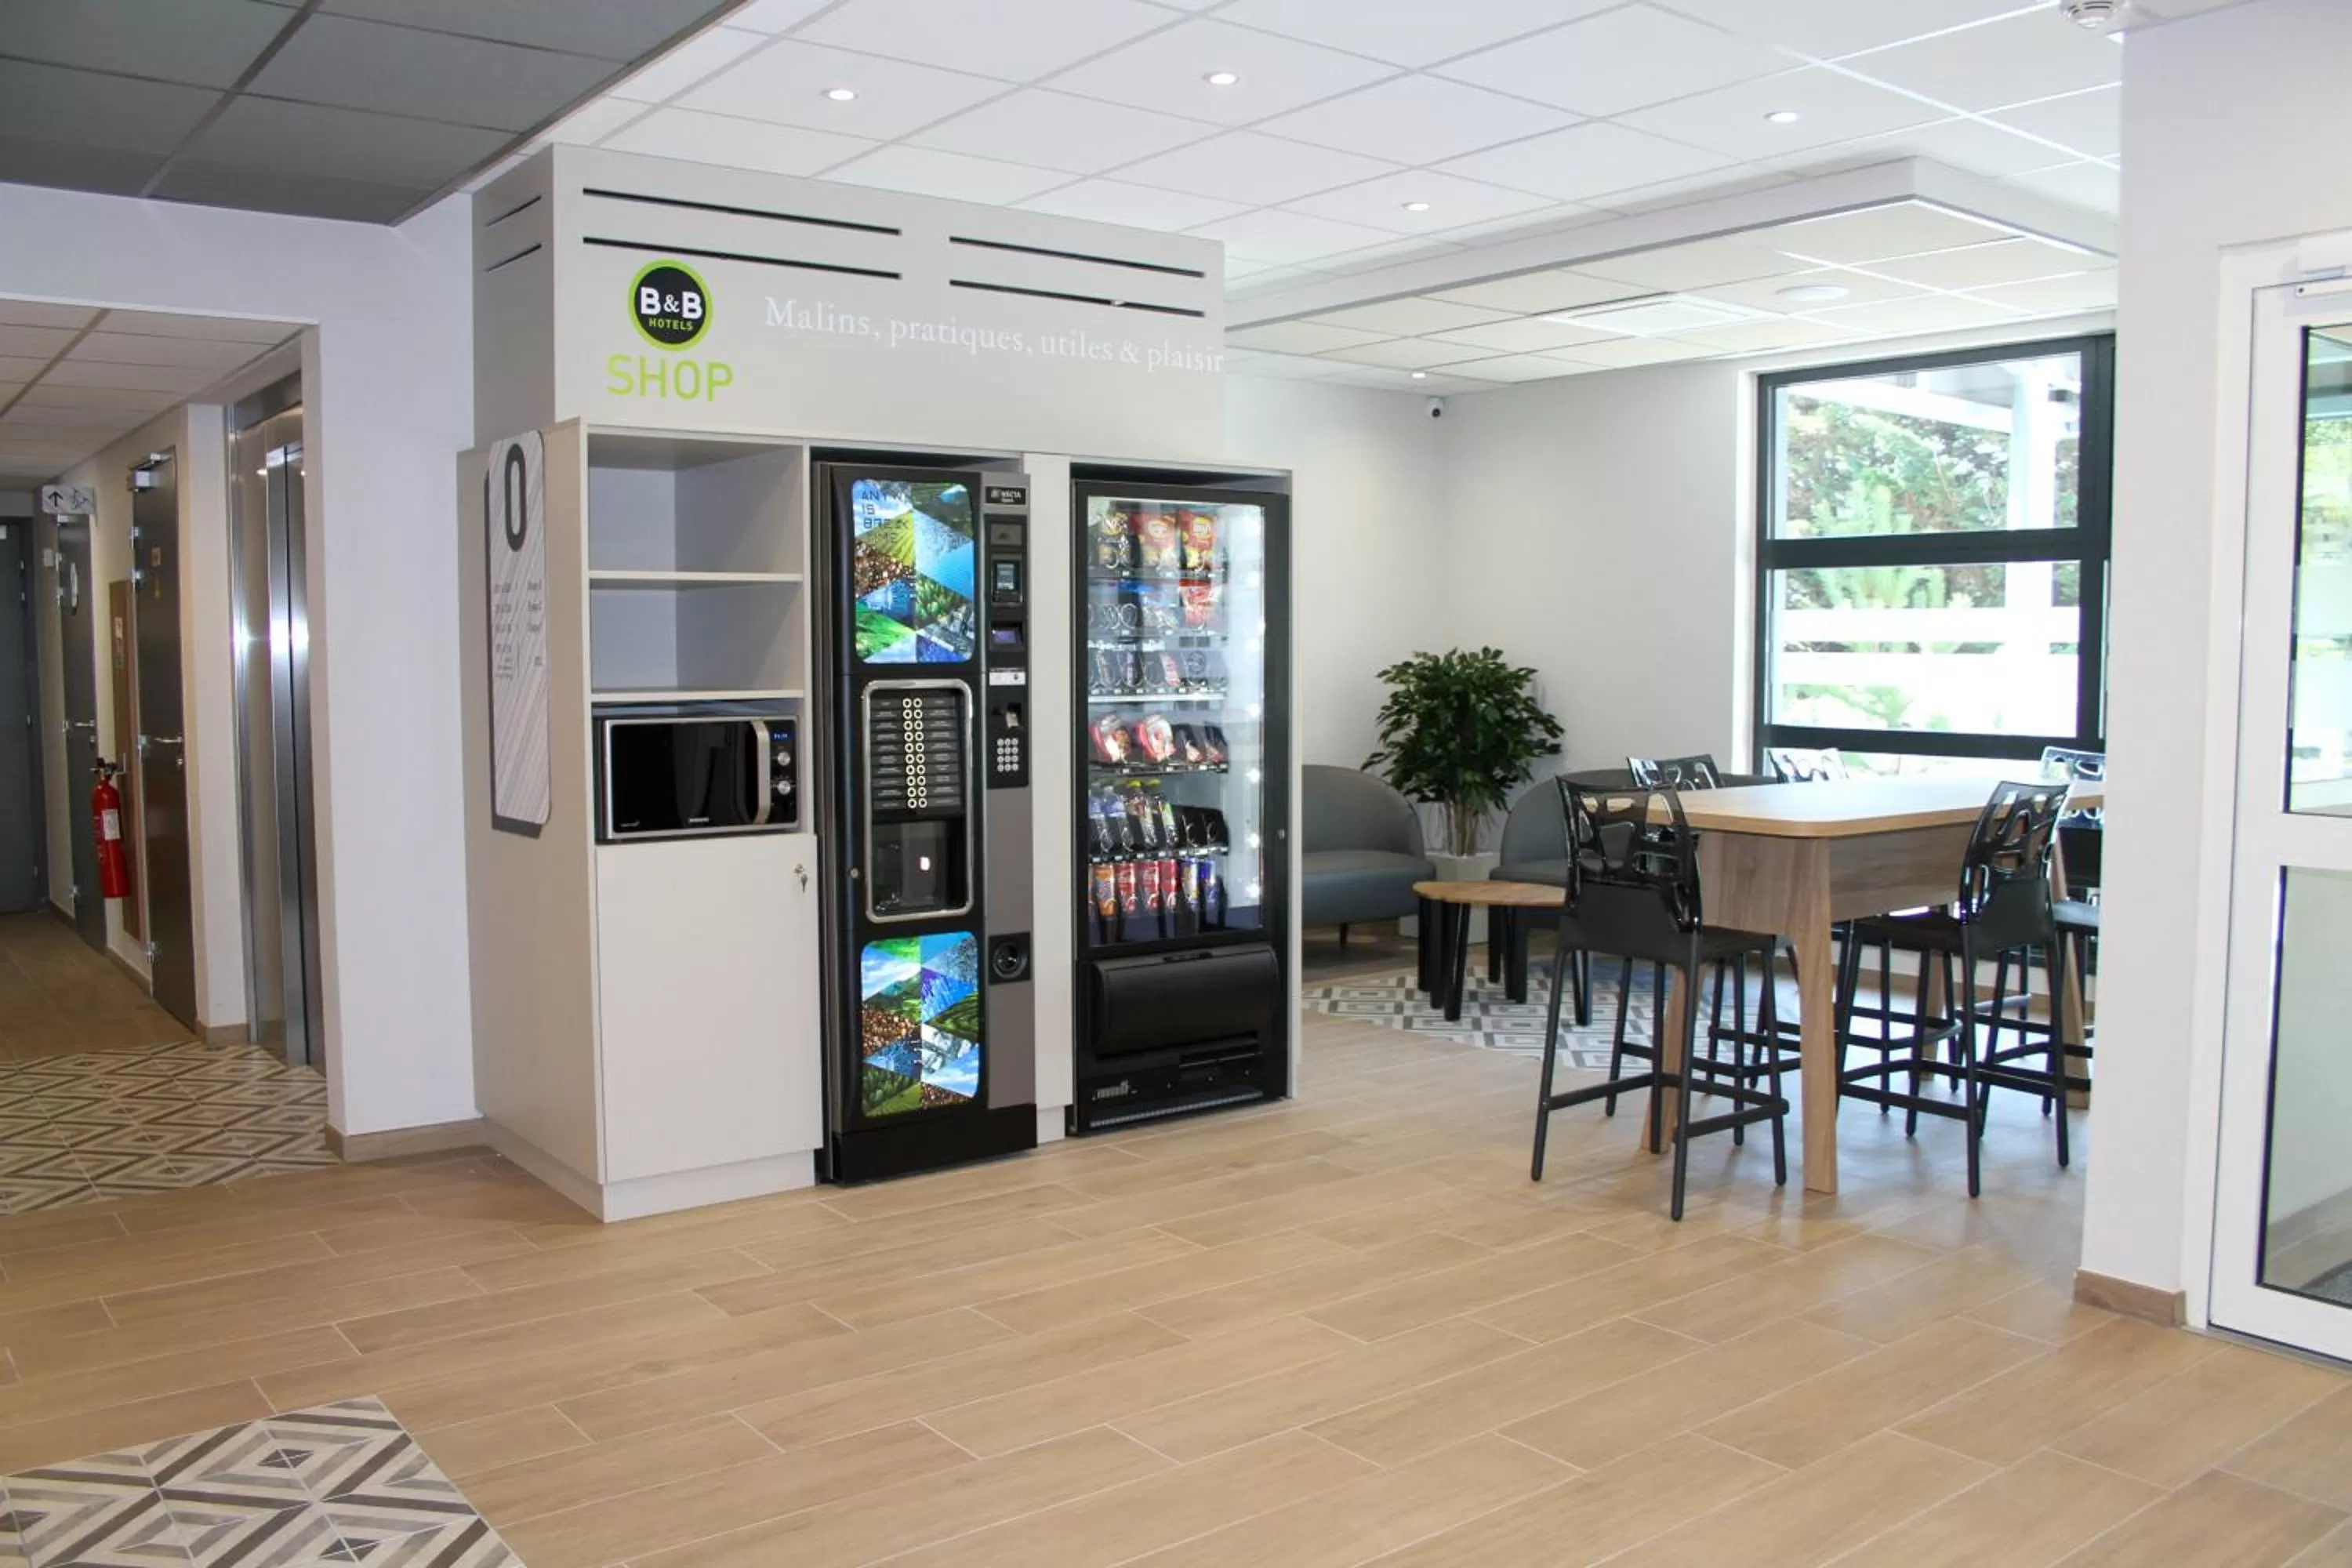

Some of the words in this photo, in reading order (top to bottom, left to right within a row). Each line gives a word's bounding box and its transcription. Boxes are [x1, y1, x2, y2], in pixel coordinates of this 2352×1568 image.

[641, 286, 703, 320] B&B
[648, 318, 694, 332] HOTELS
[764, 296, 881, 343] Malins,
[890, 317, 1033, 355] pratiques,
[1040, 329, 1114, 361] utiles
[1119, 338, 1142, 365] &
[1147, 338, 1225, 374] plaisir
[606, 354, 734, 402] SHOP
[504, 443, 528, 553] 0
